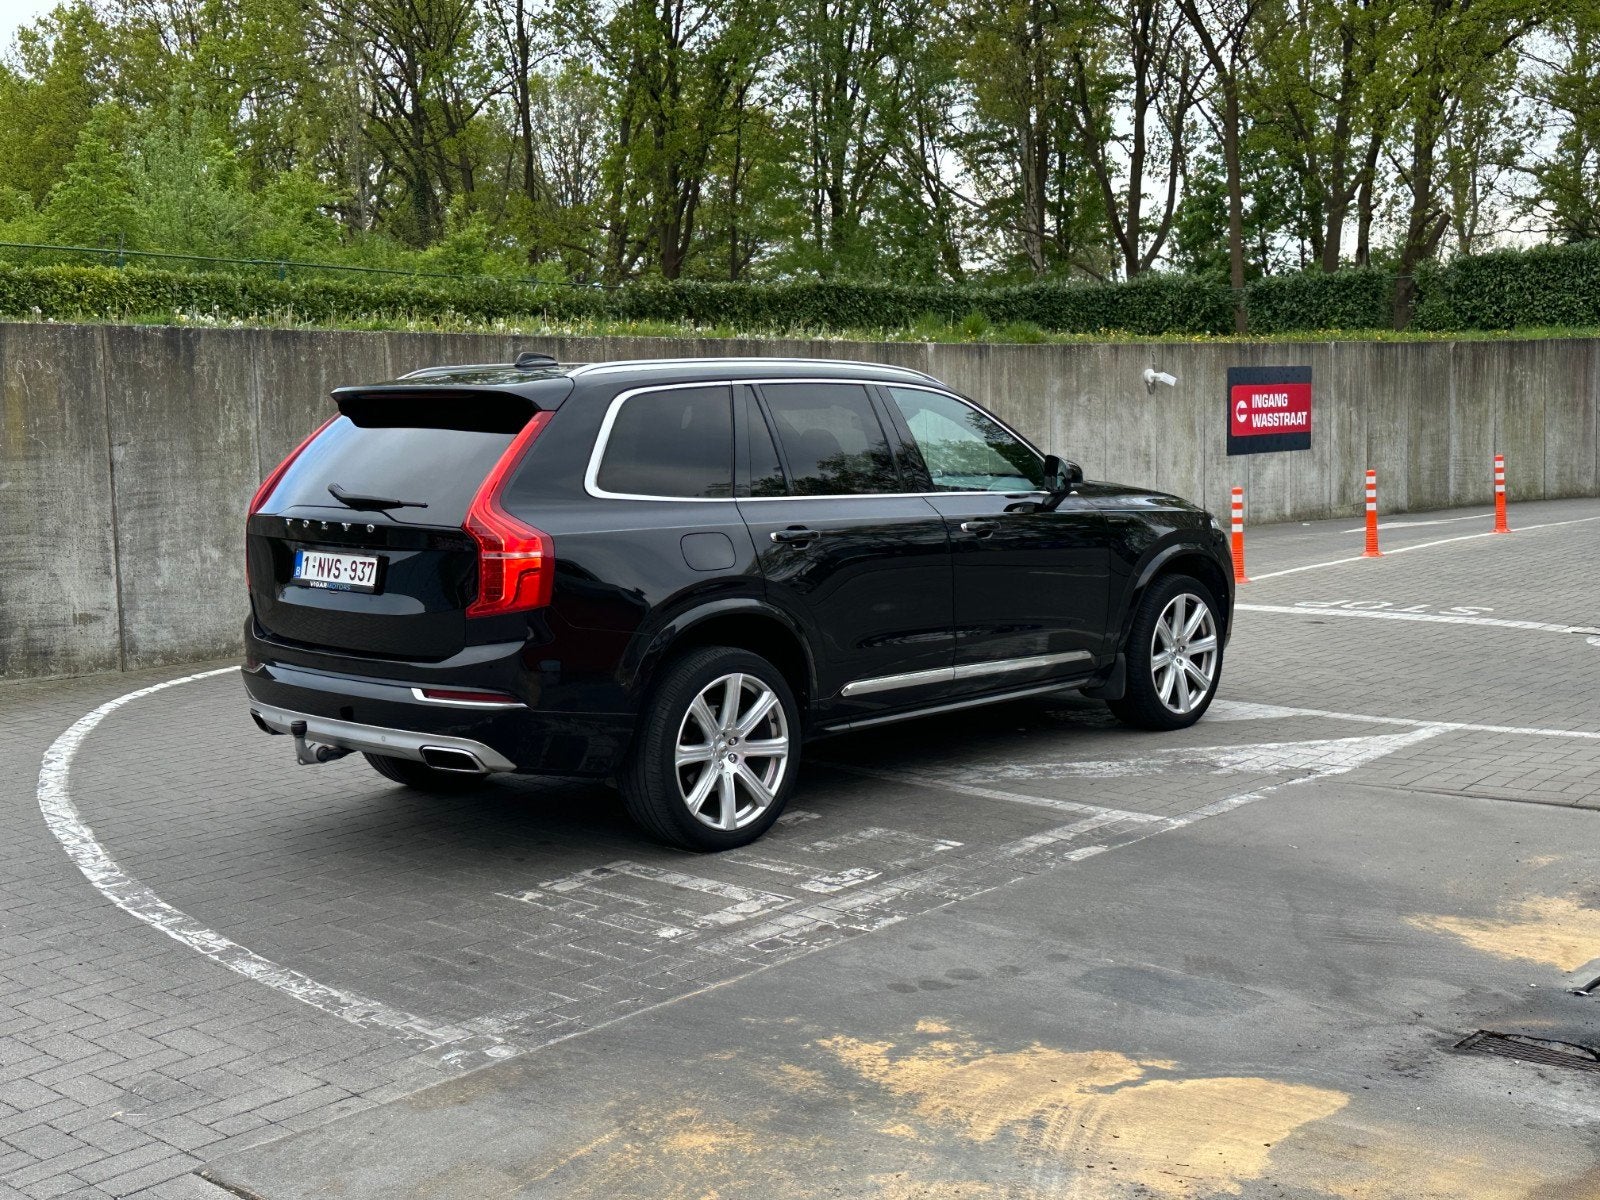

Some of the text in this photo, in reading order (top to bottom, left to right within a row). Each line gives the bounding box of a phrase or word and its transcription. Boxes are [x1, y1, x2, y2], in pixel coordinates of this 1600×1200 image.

[1251, 393, 1288, 409] INGANG
[1251, 411, 1308, 428] WASSTRAAT
[285, 518, 375, 533] VOLVO
